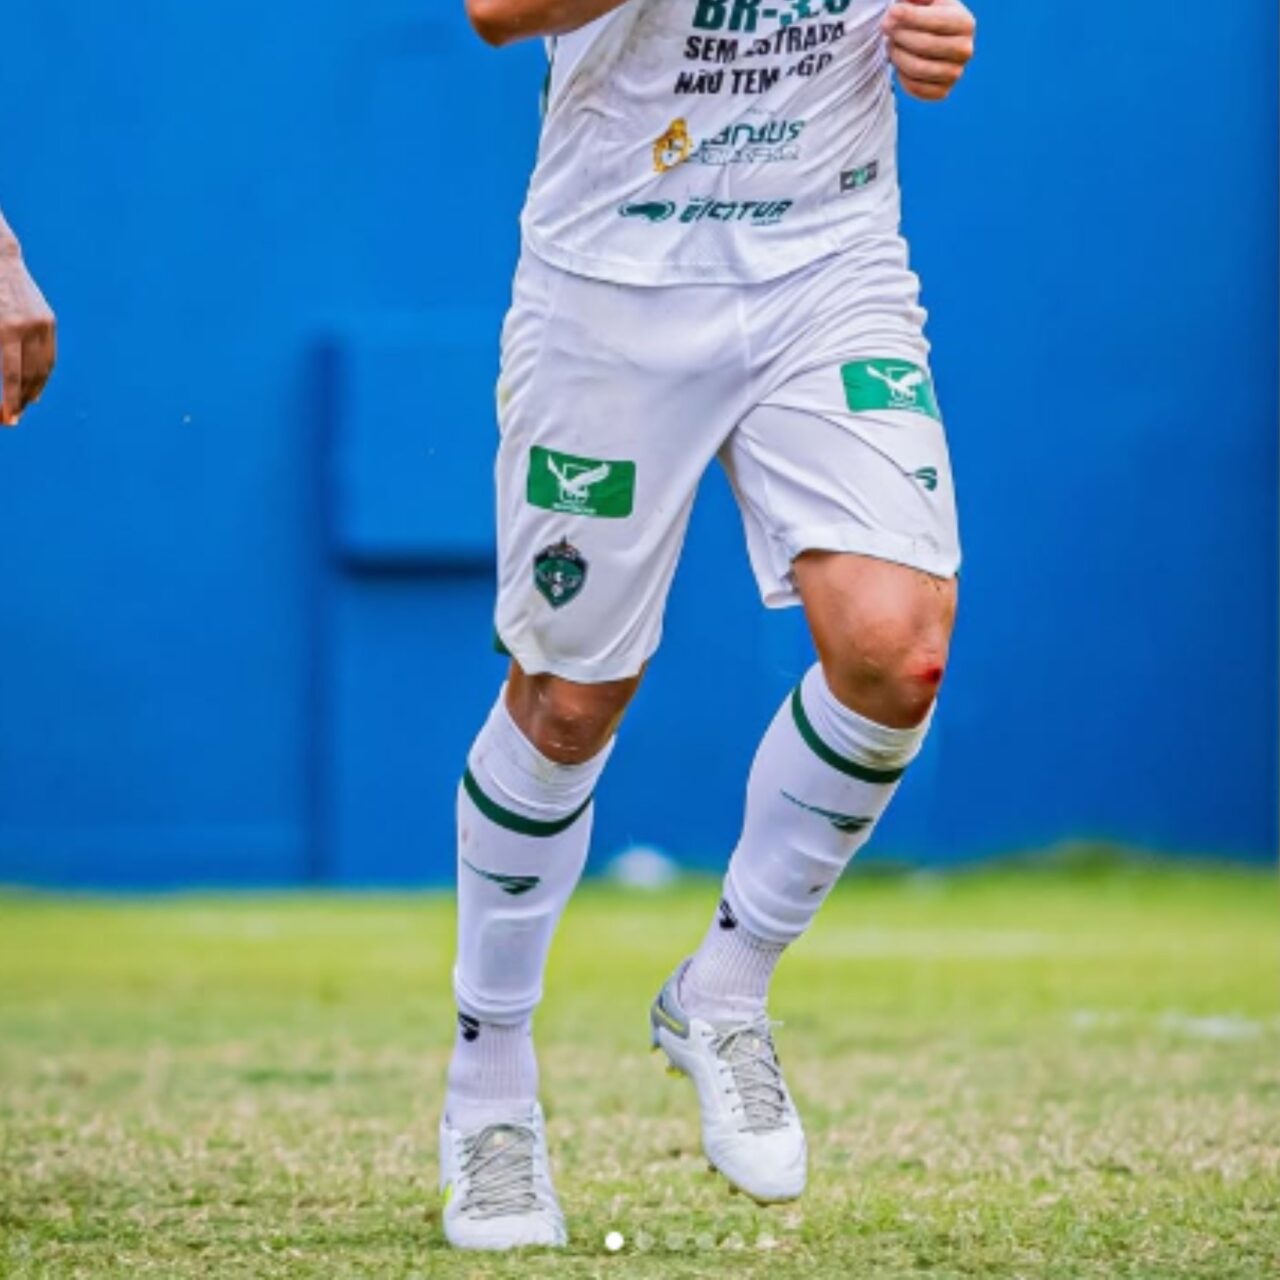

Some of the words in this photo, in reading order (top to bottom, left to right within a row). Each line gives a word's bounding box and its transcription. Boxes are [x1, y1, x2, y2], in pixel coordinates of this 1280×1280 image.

[684, 35, 738, 63] SEM
[674, 69, 724, 95] NÃO
[730, 69, 780, 94] TEM
